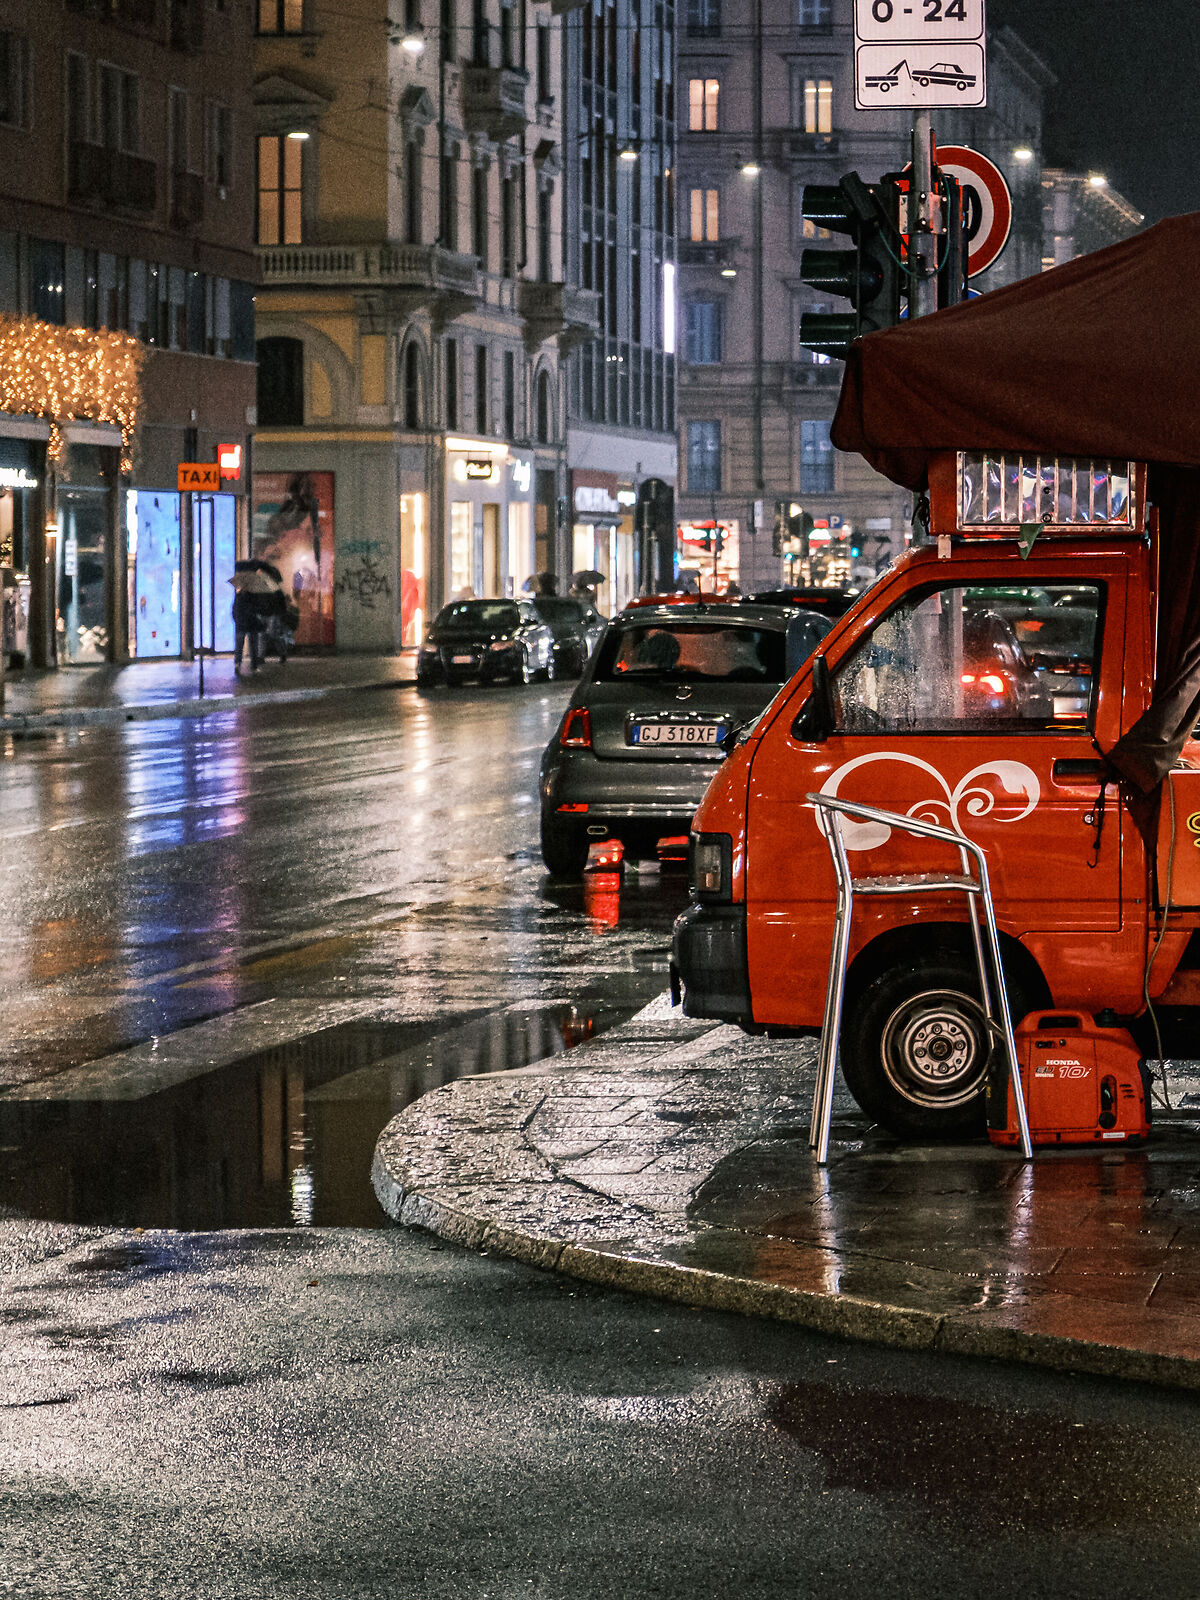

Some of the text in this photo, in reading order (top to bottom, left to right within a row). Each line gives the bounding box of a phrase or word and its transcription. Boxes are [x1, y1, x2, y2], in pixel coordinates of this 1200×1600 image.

[872, 0, 893, 23] 0
[923, 0, 967, 22] 24
[180, 470, 217, 484] TAXI
[641, 727, 716, 742] GJ 318XF
